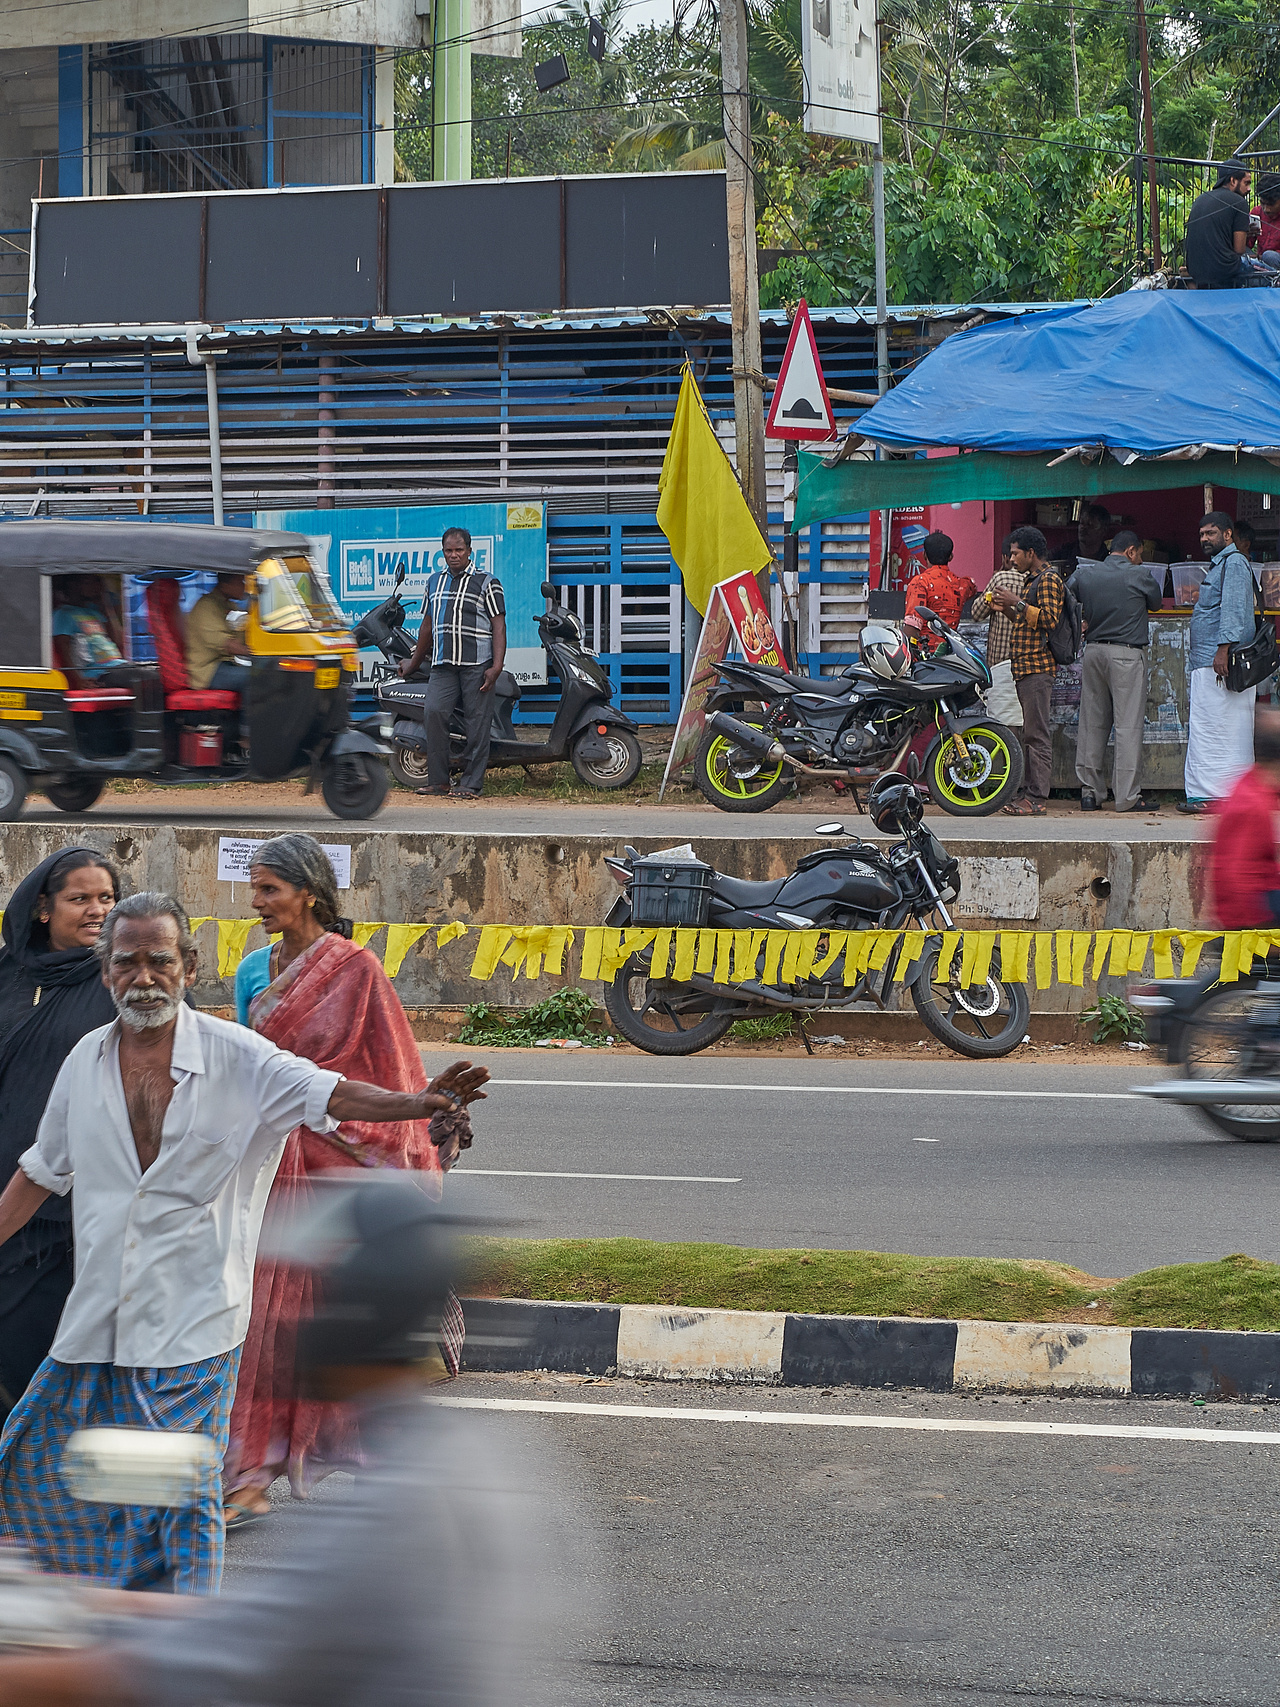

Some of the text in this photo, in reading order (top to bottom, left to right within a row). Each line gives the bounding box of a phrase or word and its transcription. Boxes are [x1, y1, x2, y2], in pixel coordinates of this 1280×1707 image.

[348, 560, 368, 574] Birla
[349, 572, 373, 586] White
[959, 904, 974, 913] Ph:
